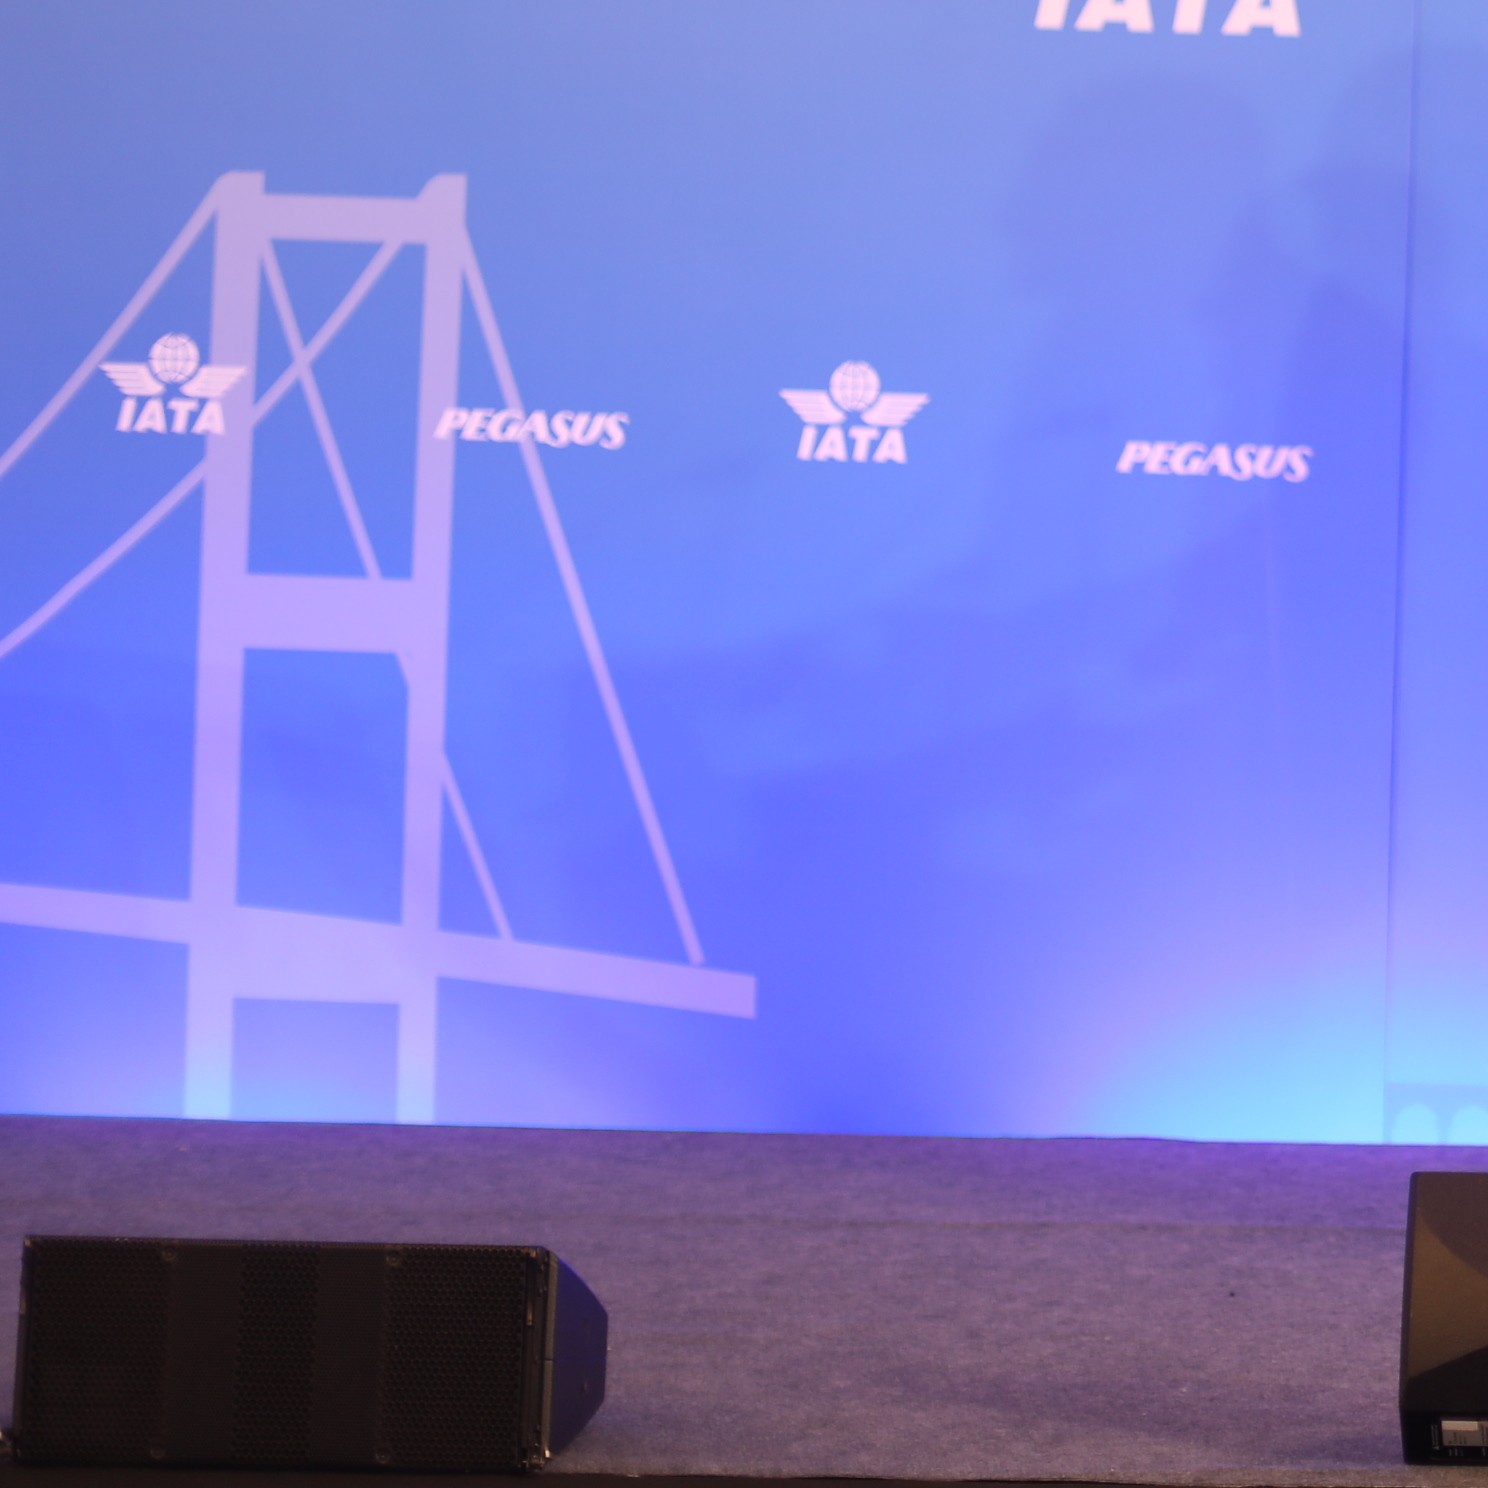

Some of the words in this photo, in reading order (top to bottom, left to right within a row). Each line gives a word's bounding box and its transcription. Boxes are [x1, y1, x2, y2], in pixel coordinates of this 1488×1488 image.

[115, 397, 227, 436] IATA
[431, 406, 630, 450] PEGASUS
[797, 424, 907, 464] IATA
[1117, 442, 1311, 481] PEGASUS
